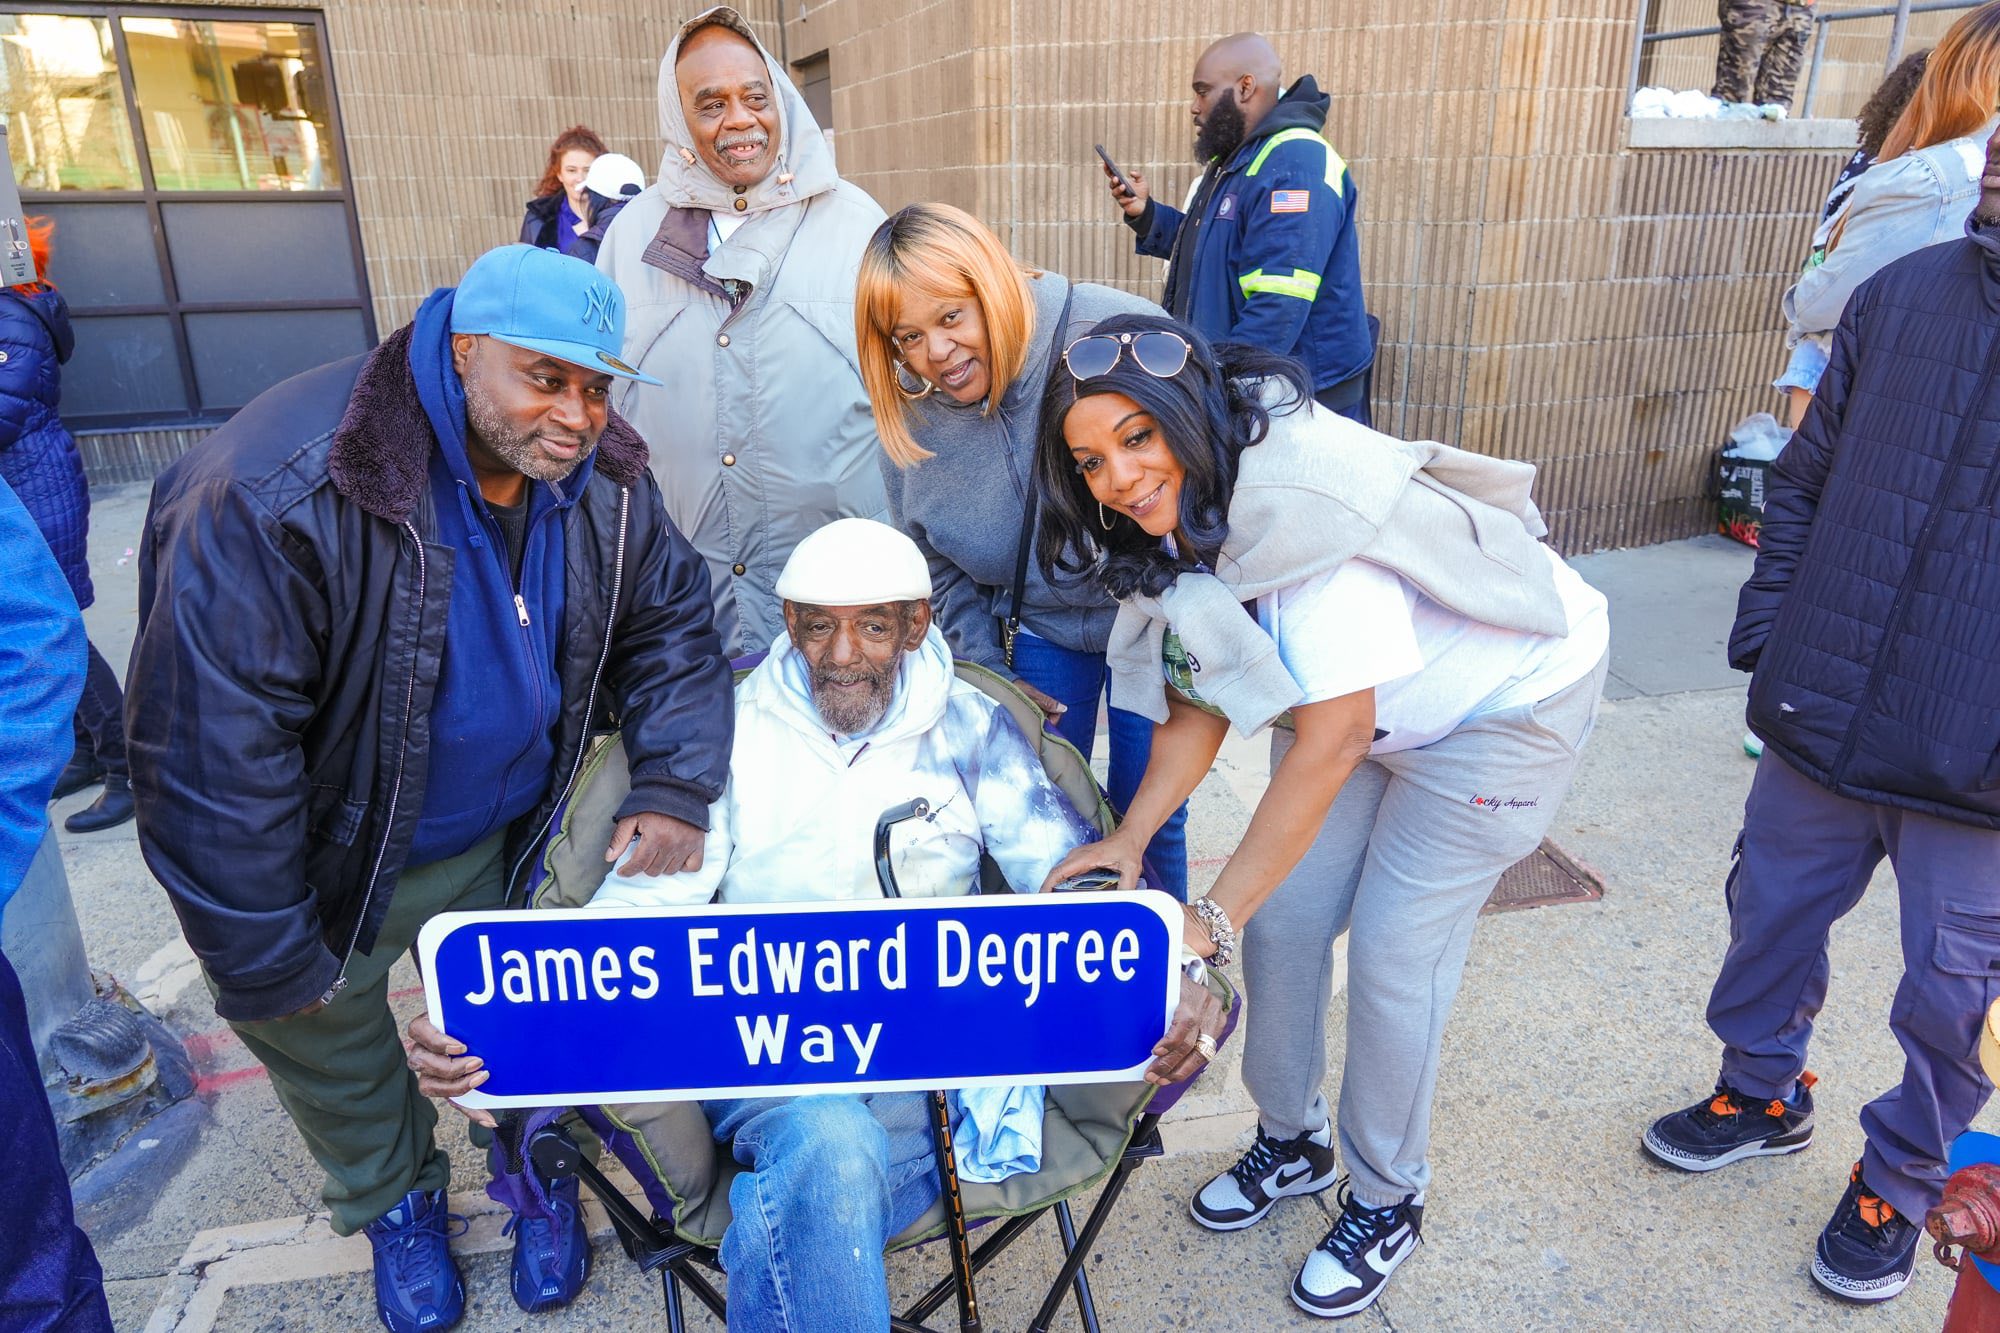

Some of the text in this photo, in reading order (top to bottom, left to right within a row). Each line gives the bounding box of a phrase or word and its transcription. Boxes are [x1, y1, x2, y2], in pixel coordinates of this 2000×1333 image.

[1504, 796, 1539, 809] Apparel
[465, 919, 1140, 1008] James Edward Degree
[735, 1014, 883, 1075] Way
